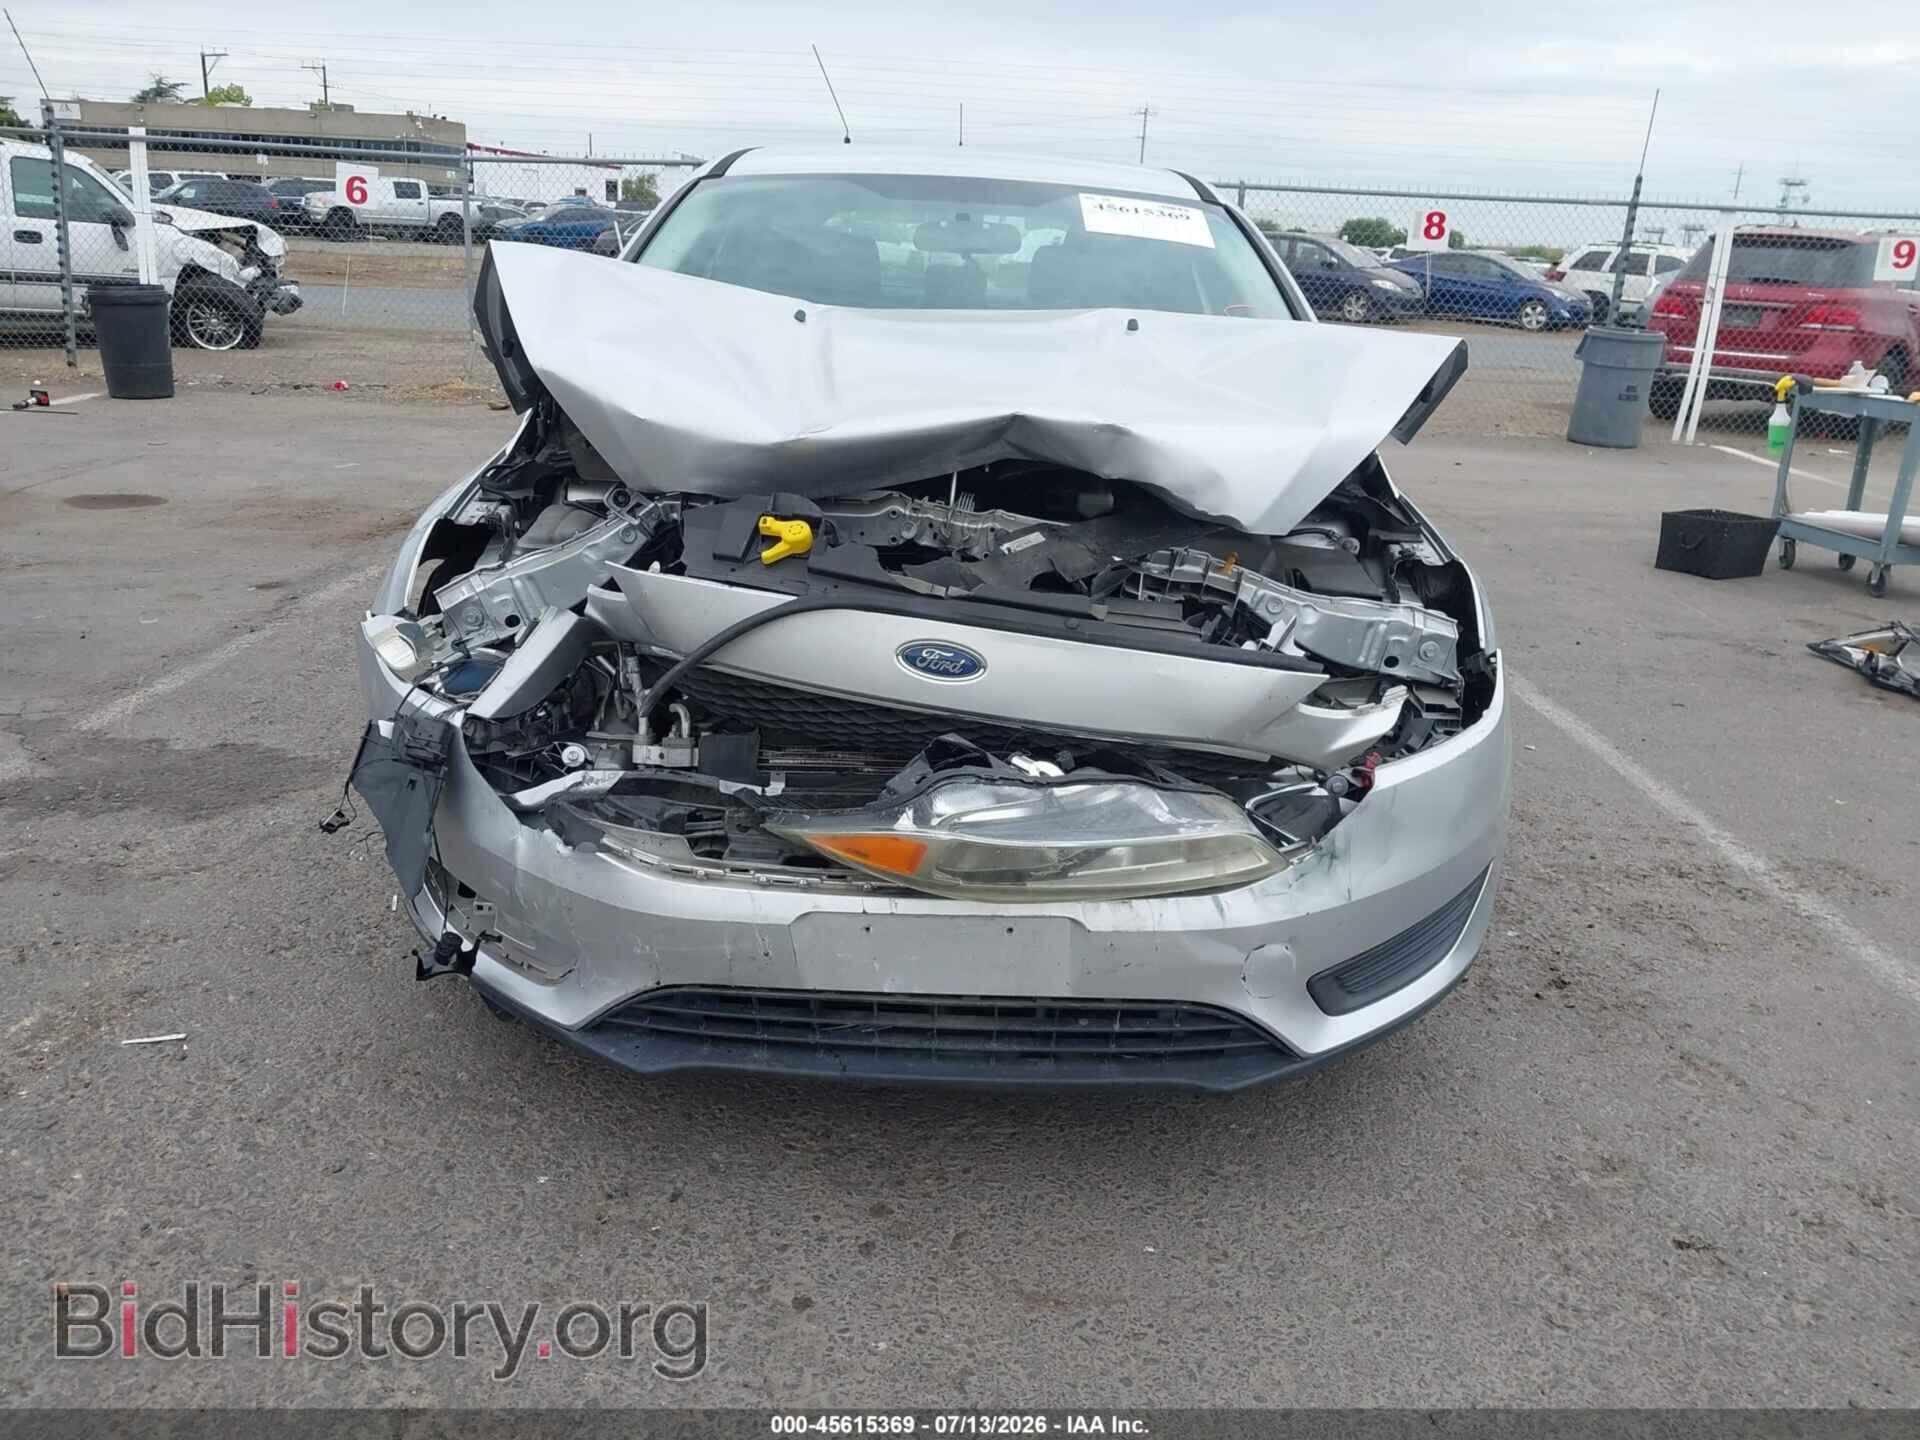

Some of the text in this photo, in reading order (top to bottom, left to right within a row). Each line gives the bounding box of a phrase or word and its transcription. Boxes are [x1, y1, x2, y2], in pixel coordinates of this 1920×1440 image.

[345, 175, 369, 205] 6
[1423, 211, 1446, 240] 8
[1892, 240, 1916, 269] 9
[915, 648, 966, 674] Ford
